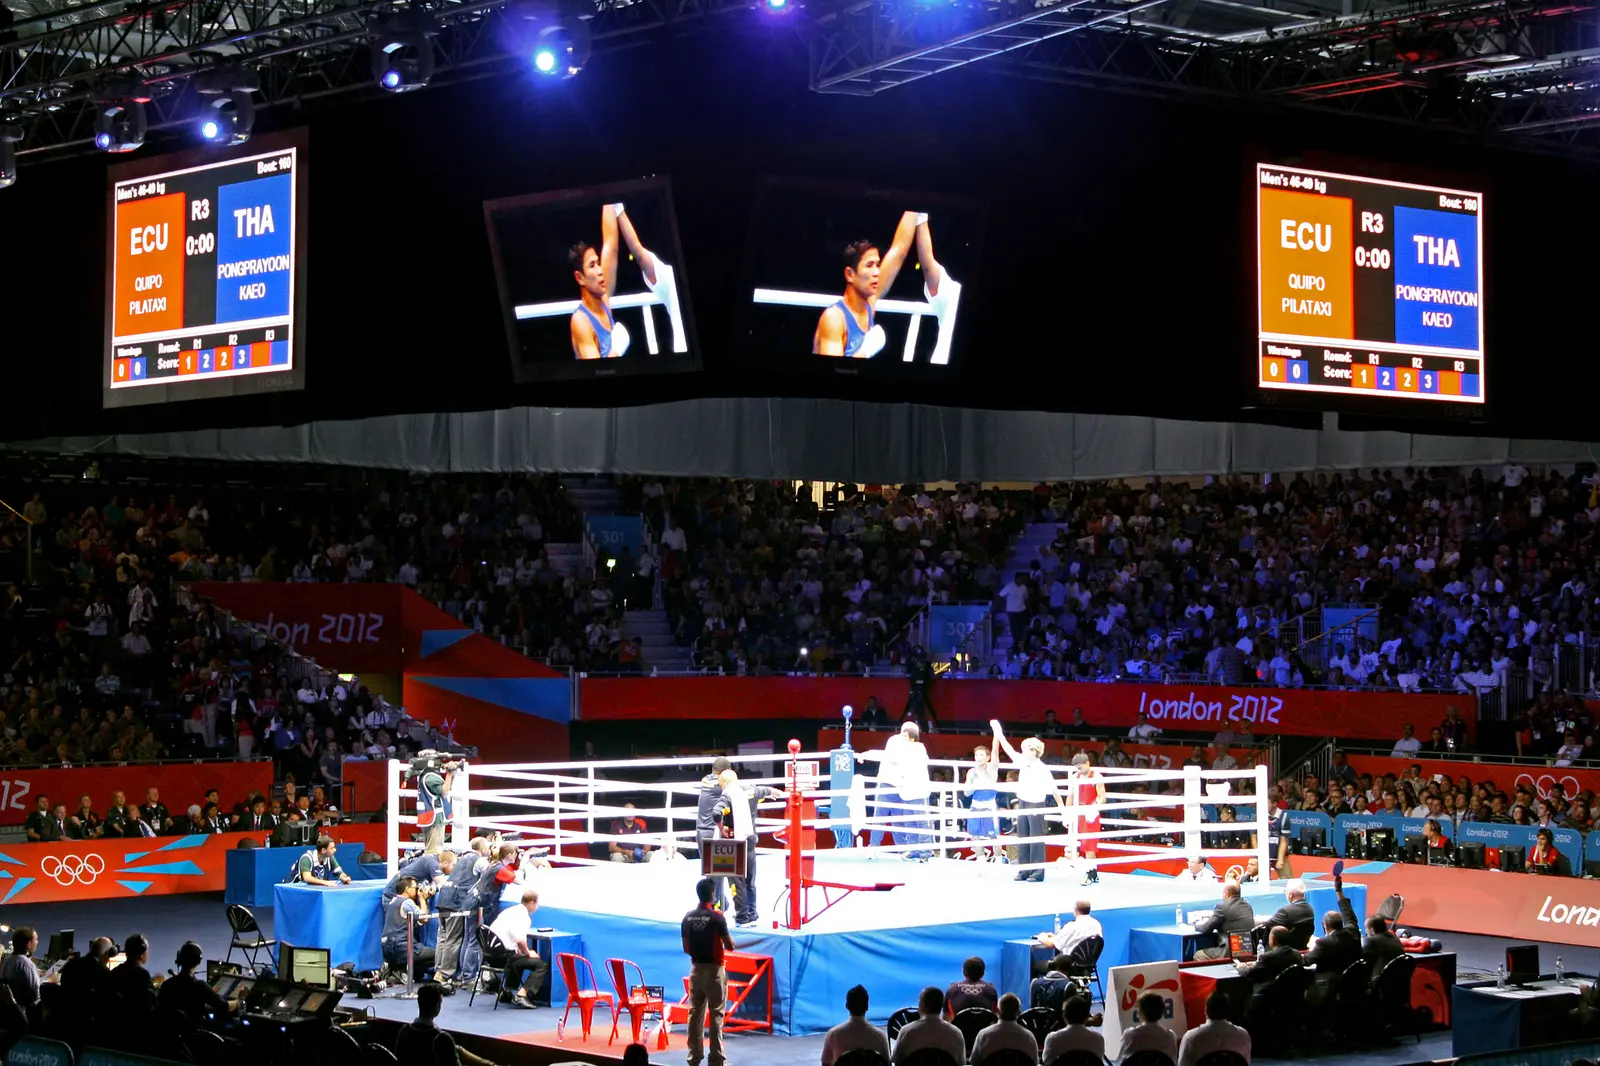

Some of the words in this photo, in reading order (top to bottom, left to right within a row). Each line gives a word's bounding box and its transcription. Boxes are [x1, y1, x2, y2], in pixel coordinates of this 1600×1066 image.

[257, 161, 277, 175] Bout:
[117, 184, 138, 200] Men's
[138, 181, 156, 196] 46-49
[157, 180, 165, 195] kg
[1261, 171, 1288, 186] Men's
[1289, 176, 1313, 190] 46-49
[1315, 179, 1327, 194] kg
[192, 199, 210, 221] R3
[1439, 195, 1462, 209] Bout:
[1463, 199, 1478, 211] 160
[234, 205, 275, 238] THA
[1361, 211, 1384, 233] R3
[130, 222, 169, 256] ECU
[186, 232, 215, 256] 0:00
[1280, 219, 1332, 252] ECU
[1355, 246, 1391, 269] 0:00
[1413, 235, 1461, 267] THA
[218, 254, 290, 279] PONGPRAYOON
[135, 274, 162, 291] QUIPO
[239, 282, 266, 300] KAEO
[1288, 273, 1325, 291] QUIPO
[129, 296, 166, 315] PILATAXI
[1396, 284, 1478, 307] PONGPRAYOON
[1282, 298, 1332, 316] PILATAXI
[1422, 311, 1453, 328] KAEO
[193, 339, 202, 350] R1
[229, 335, 238, 346] R2
[265, 329, 275, 342] R3
[118, 363, 125, 377] 0
[134, 361, 141, 376] 0
[157, 357, 180, 370] Score:
[185, 356, 191, 369] 1
[203, 354, 210, 368] 2
[220, 352, 227, 366] 2
[238, 350, 246, 364] 3
[1270, 362, 1278, 377] 0
[1292, 364, 1300, 378] 0
[1369, 354, 1380, 365] R1
[1412, 357, 1423, 368] R2
[1454, 360, 1465, 372] R3
[1323, 366, 1352, 379] Score:
[1361, 369, 1367, 383] 1
[1382, 371, 1390, 385] 2
[1404, 373, 1411, 387] 2
[1425, 374, 1432, 388] 3
[318, 612, 383, 644] 2012
[1139, 691, 1222, 721] London
[1228, 694, 1284, 724] 2012
[1343, 820, 1366, 829] London
[1402, 823, 1424, 833] Londo
[1466, 827, 1491, 837] London
[1492, 829, 1508, 839] 2012
[1555, 833, 1572, 843] 2012
[714, 844, 734, 855] ECU
